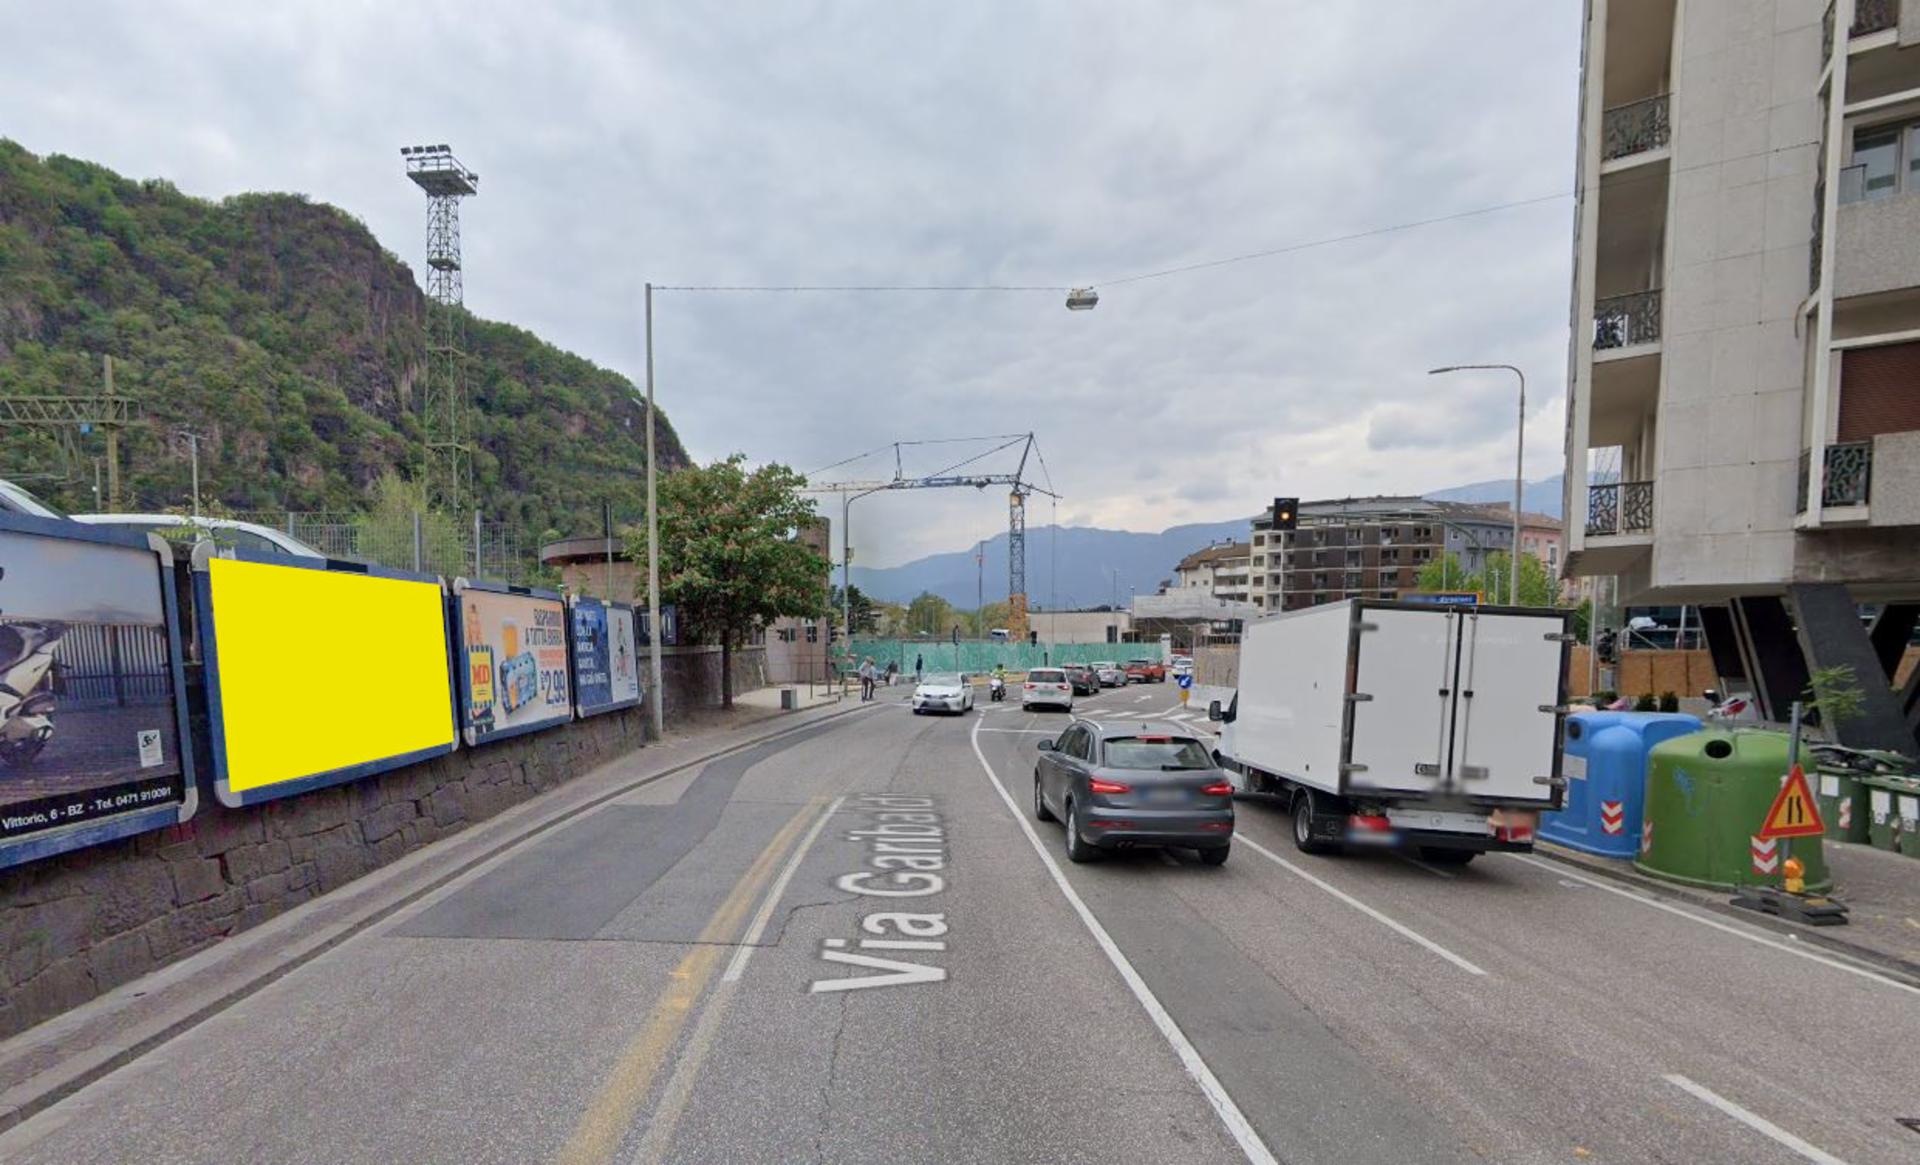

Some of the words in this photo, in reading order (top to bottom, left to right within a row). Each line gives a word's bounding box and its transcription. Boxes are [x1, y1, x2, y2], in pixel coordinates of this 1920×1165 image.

[50, 808, 58, 820] 6
[68, 804, 84, 817] BZ
[95, 800, 113, 812] Tel.
[116, 795, 138, 806] 0471
[838, 793, 944, 897] Garibaldi
[811, 912, 947, 993] Via
